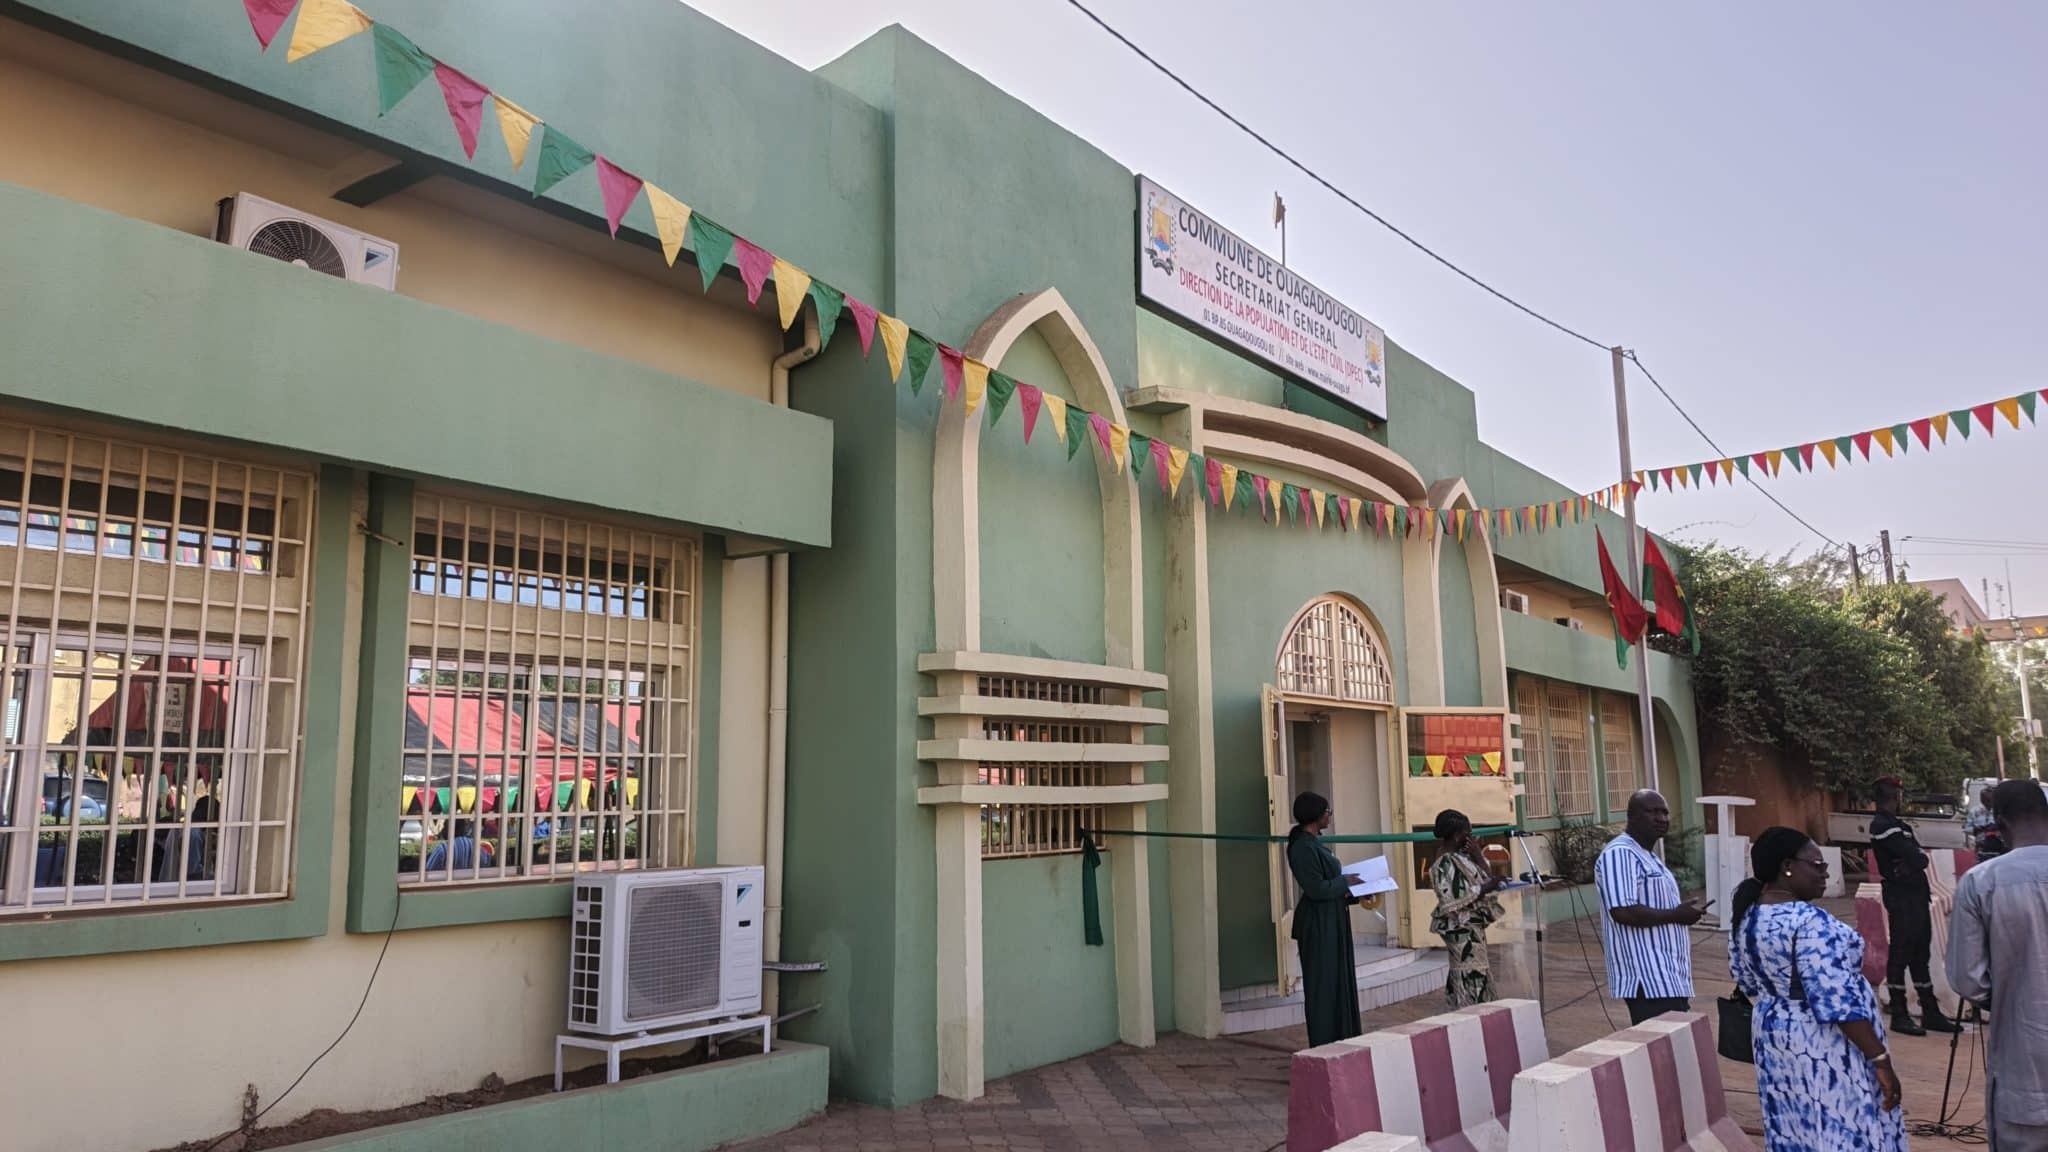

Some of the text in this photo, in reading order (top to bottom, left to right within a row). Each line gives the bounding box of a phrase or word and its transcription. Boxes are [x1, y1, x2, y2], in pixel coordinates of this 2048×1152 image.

[1178, 206, 1363, 339] COMMUNE DE OUAGADOUGOU
[1179, 266, 1222, 307] DIRECTION
[1223, 291, 1234, 313] DE
[1235, 297, 1245, 320] LA
[1245, 304, 1290, 345] POPULATION
[1291, 329, 1299, 349] ET
[1299, 334, 1308, 355] DE
[1329, 351, 1345, 374] CIVIL
[1215, 261, 1338, 350] SECRETARIAT GENERAL
[1226, 320, 1268, 352] OUAGADOUGOU
